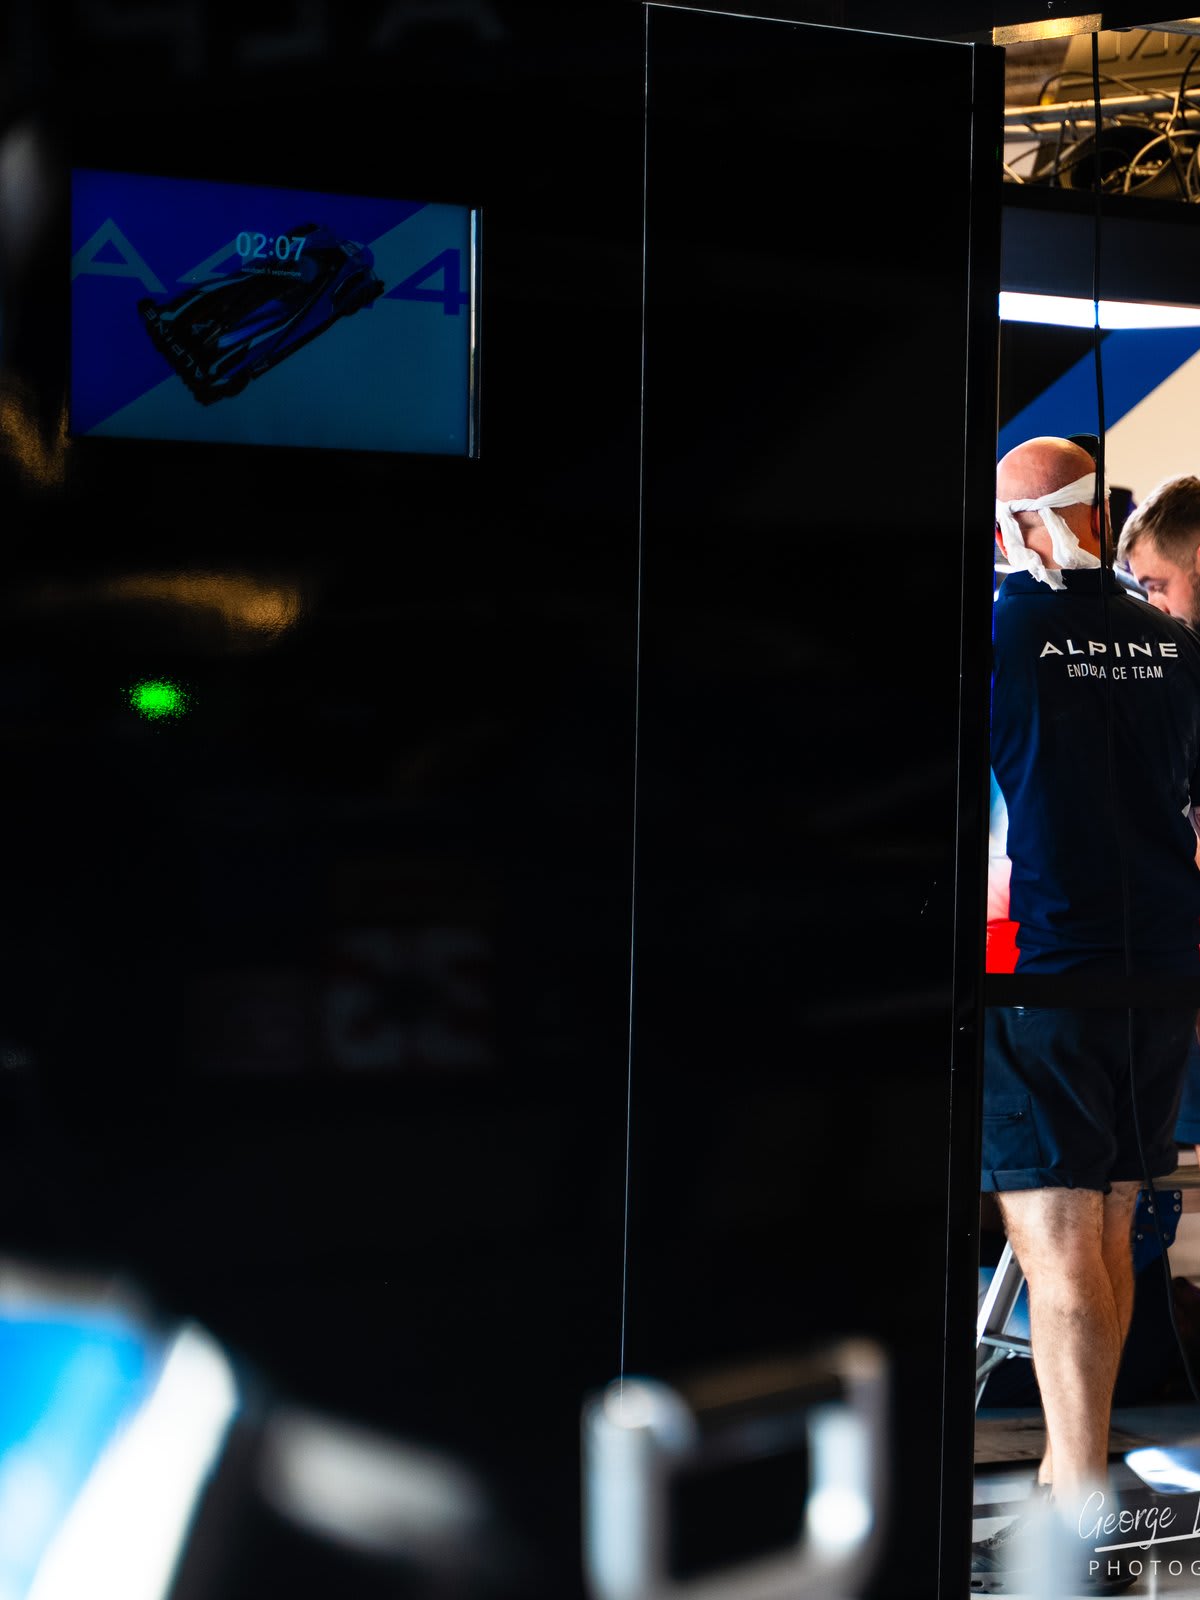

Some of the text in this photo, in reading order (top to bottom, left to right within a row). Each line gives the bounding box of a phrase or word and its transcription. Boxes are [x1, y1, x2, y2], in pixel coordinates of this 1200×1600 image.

[235, 231, 307, 262] 02:07
[1039, 638, 1179, 658] ALPINE
[1066, 663, 1164, 680] ENDURACE TEAM
